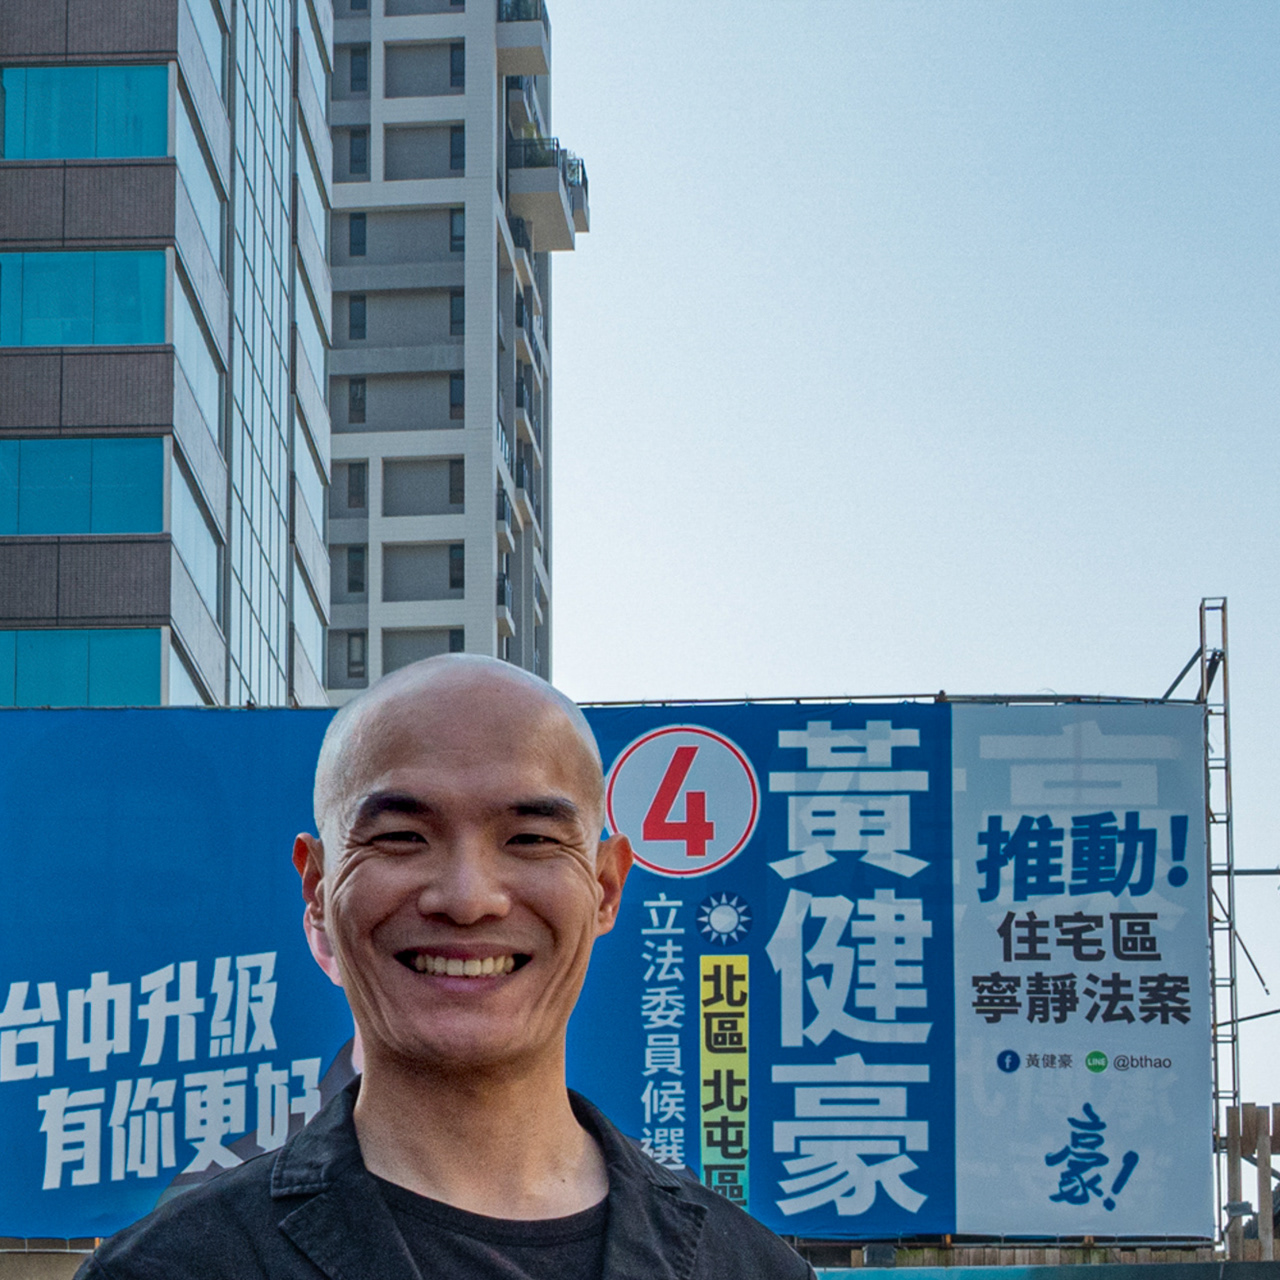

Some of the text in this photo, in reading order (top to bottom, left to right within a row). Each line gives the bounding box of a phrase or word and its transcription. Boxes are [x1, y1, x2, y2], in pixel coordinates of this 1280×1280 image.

[641, 745, 716, 858] 4
[975, 811, 1189, 903] 推動!
[766, 720, 933, 1216] 黃健豪
[996, 911, 1163, 963] 住宅區
[640, 892, 687, 1171] 立法委員候選
[971, 971, 1192, 1025] 寧靜法案
[1024, 1053, 1074, 1070] 黃健豪
[1113, 1055, 1173, 1072] @bthao
[37, 1056, 322, 1191] 有你更好
